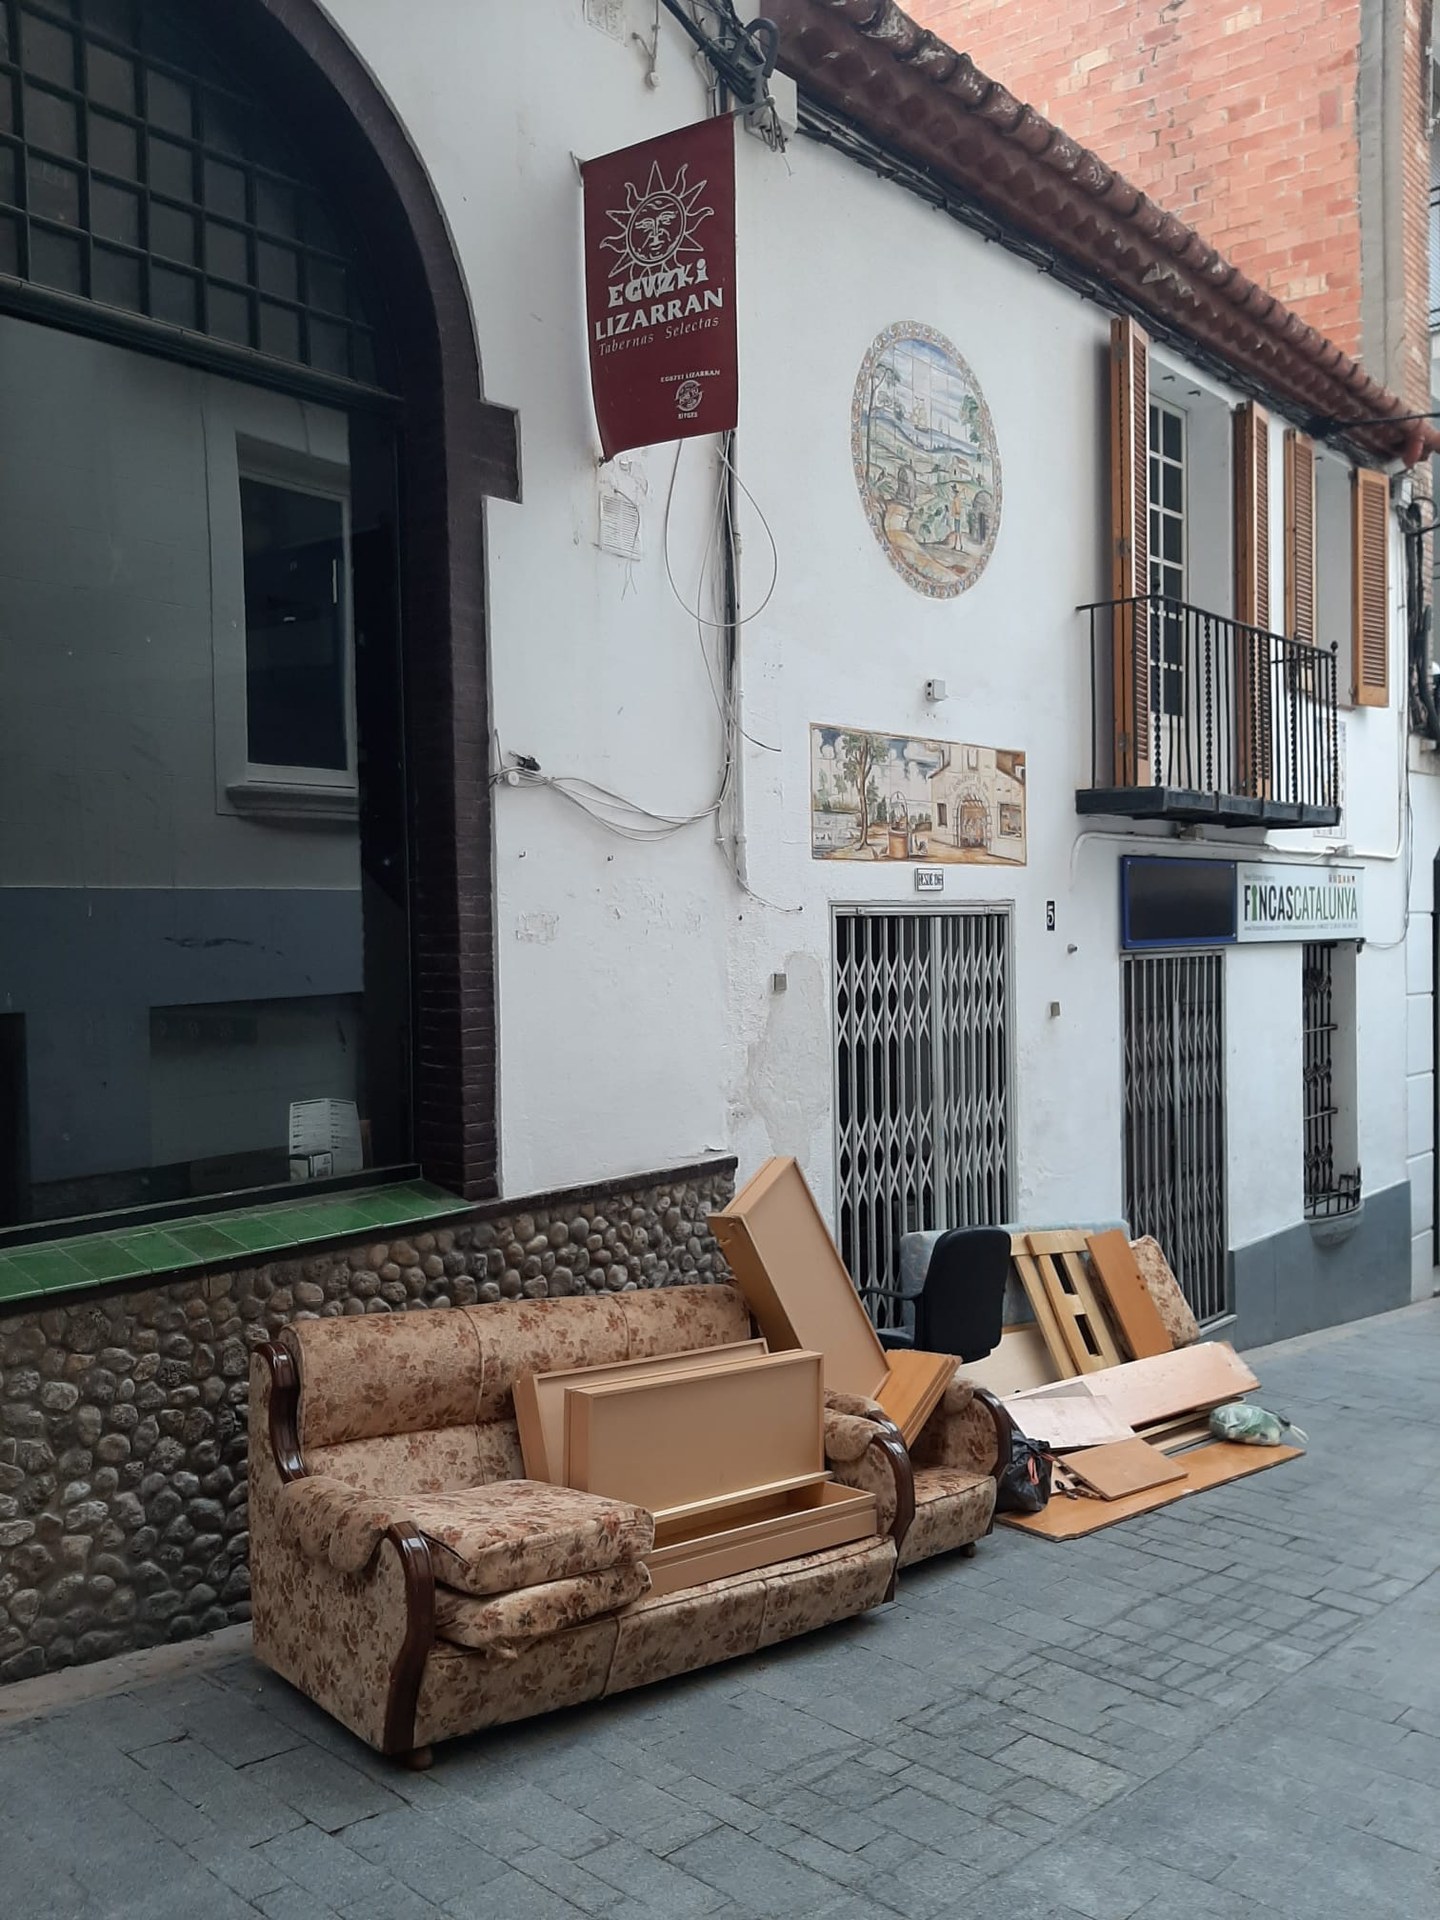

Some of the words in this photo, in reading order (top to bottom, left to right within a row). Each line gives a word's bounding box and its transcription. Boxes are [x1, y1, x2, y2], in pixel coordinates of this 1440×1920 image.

[595, 287, 723, 341] LIZARRAN
[599, 333, 655, 356] Tabernas
[665, 316, 719, 339] Selectas
[1047, 904, 1055, 927] 5
